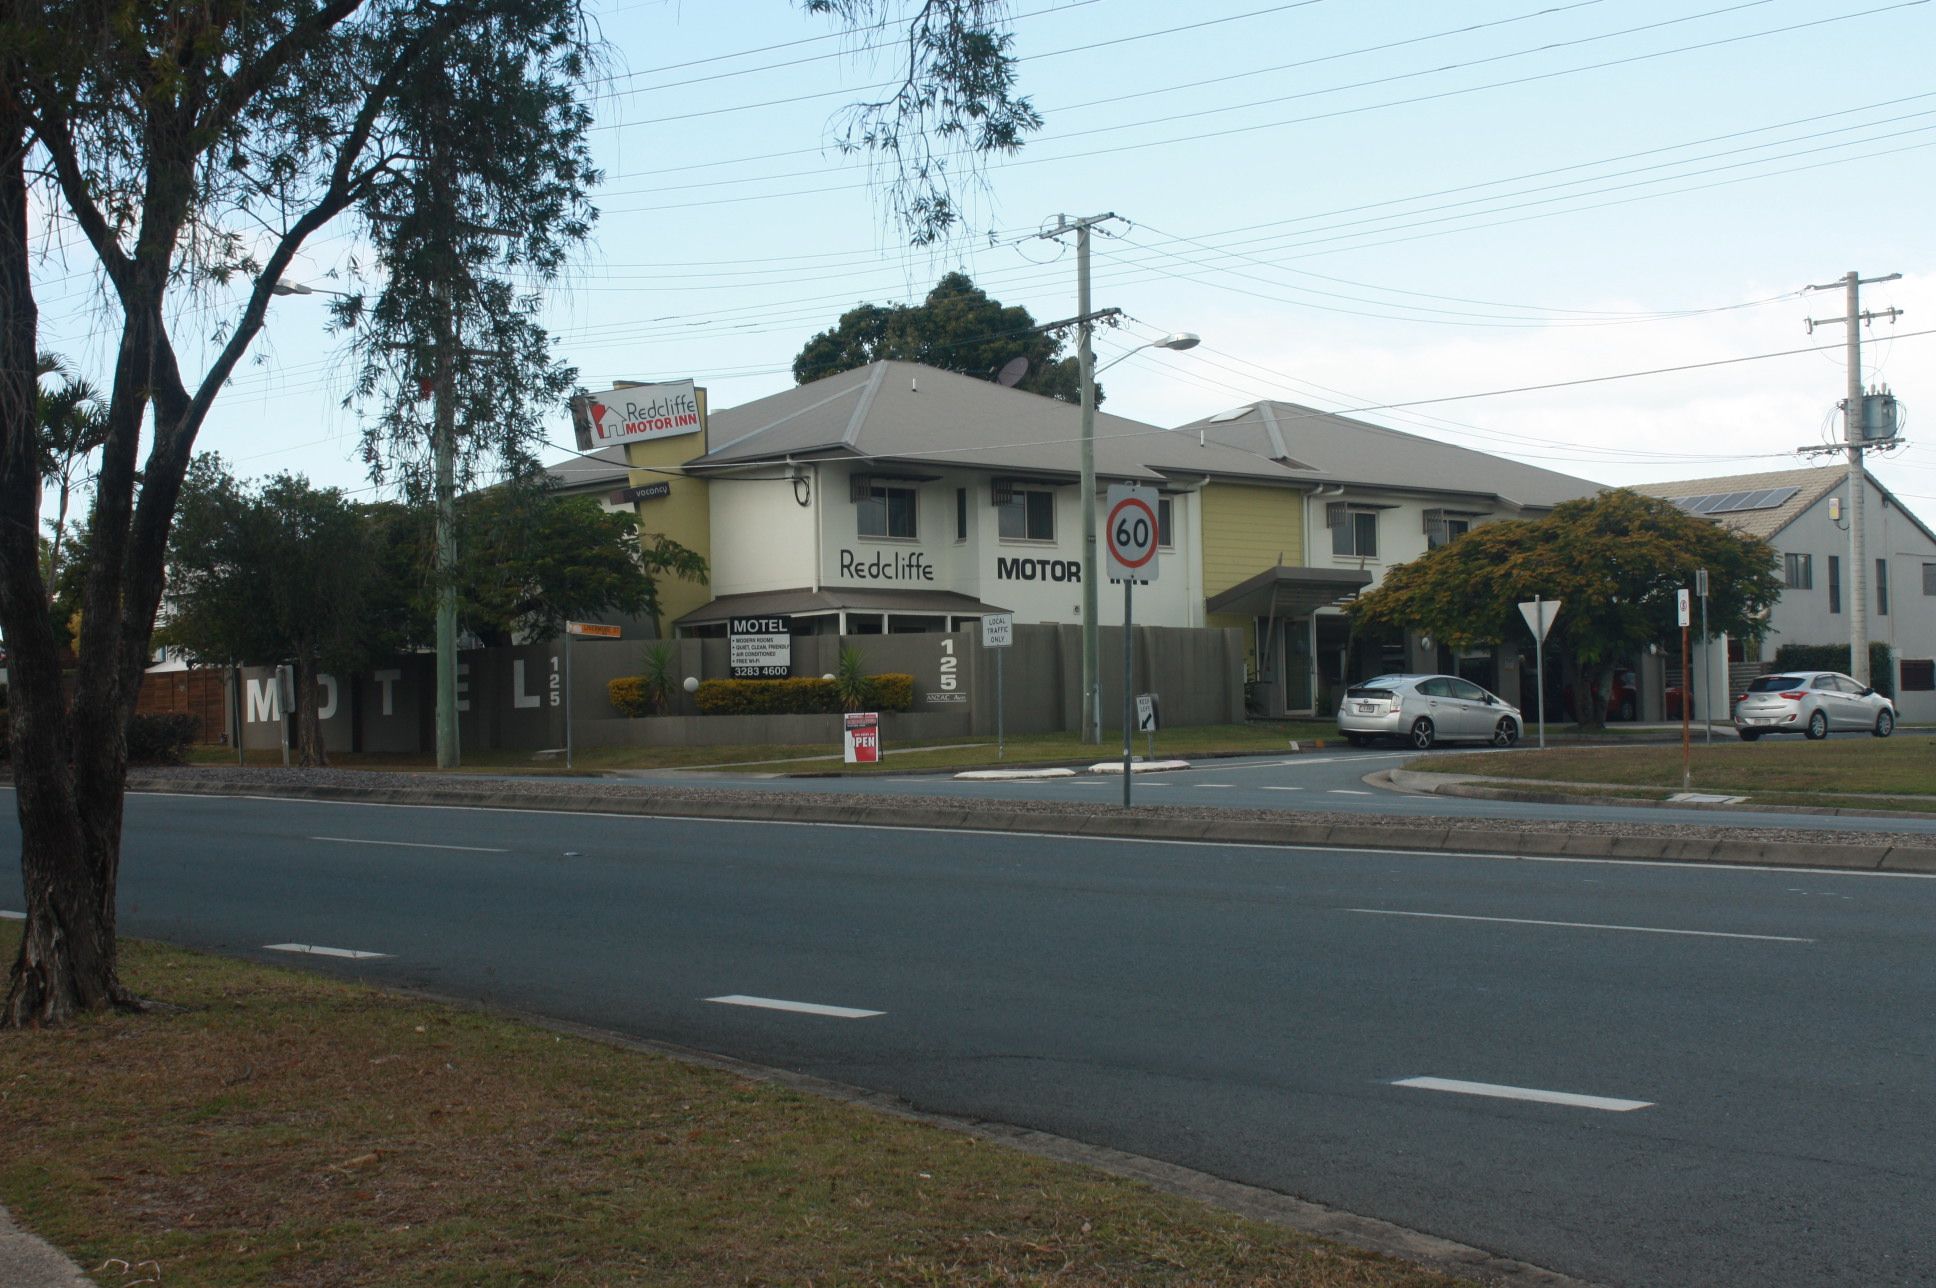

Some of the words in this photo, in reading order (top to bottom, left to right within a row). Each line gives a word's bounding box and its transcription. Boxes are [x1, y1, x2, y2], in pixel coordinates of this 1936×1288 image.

[626, 394, 696, 421] Redcliffe
[625, 416, 673, 435] MOTOR
[674, 413, 698, 427] INN
[1116, 518, 1149, 548] 60
[840, 549, 934, 581] Redcliffe
[997, 557, 1082, 583] MOTOR
[733, 619, 788, 633] MOTEL
[987, 626, 1009, 634] TRAFFIC
[989, 618, 1005, 626] LOCAL
[735, 667, 760, 676] 3283
[762, 667, 788, 676] 4600
